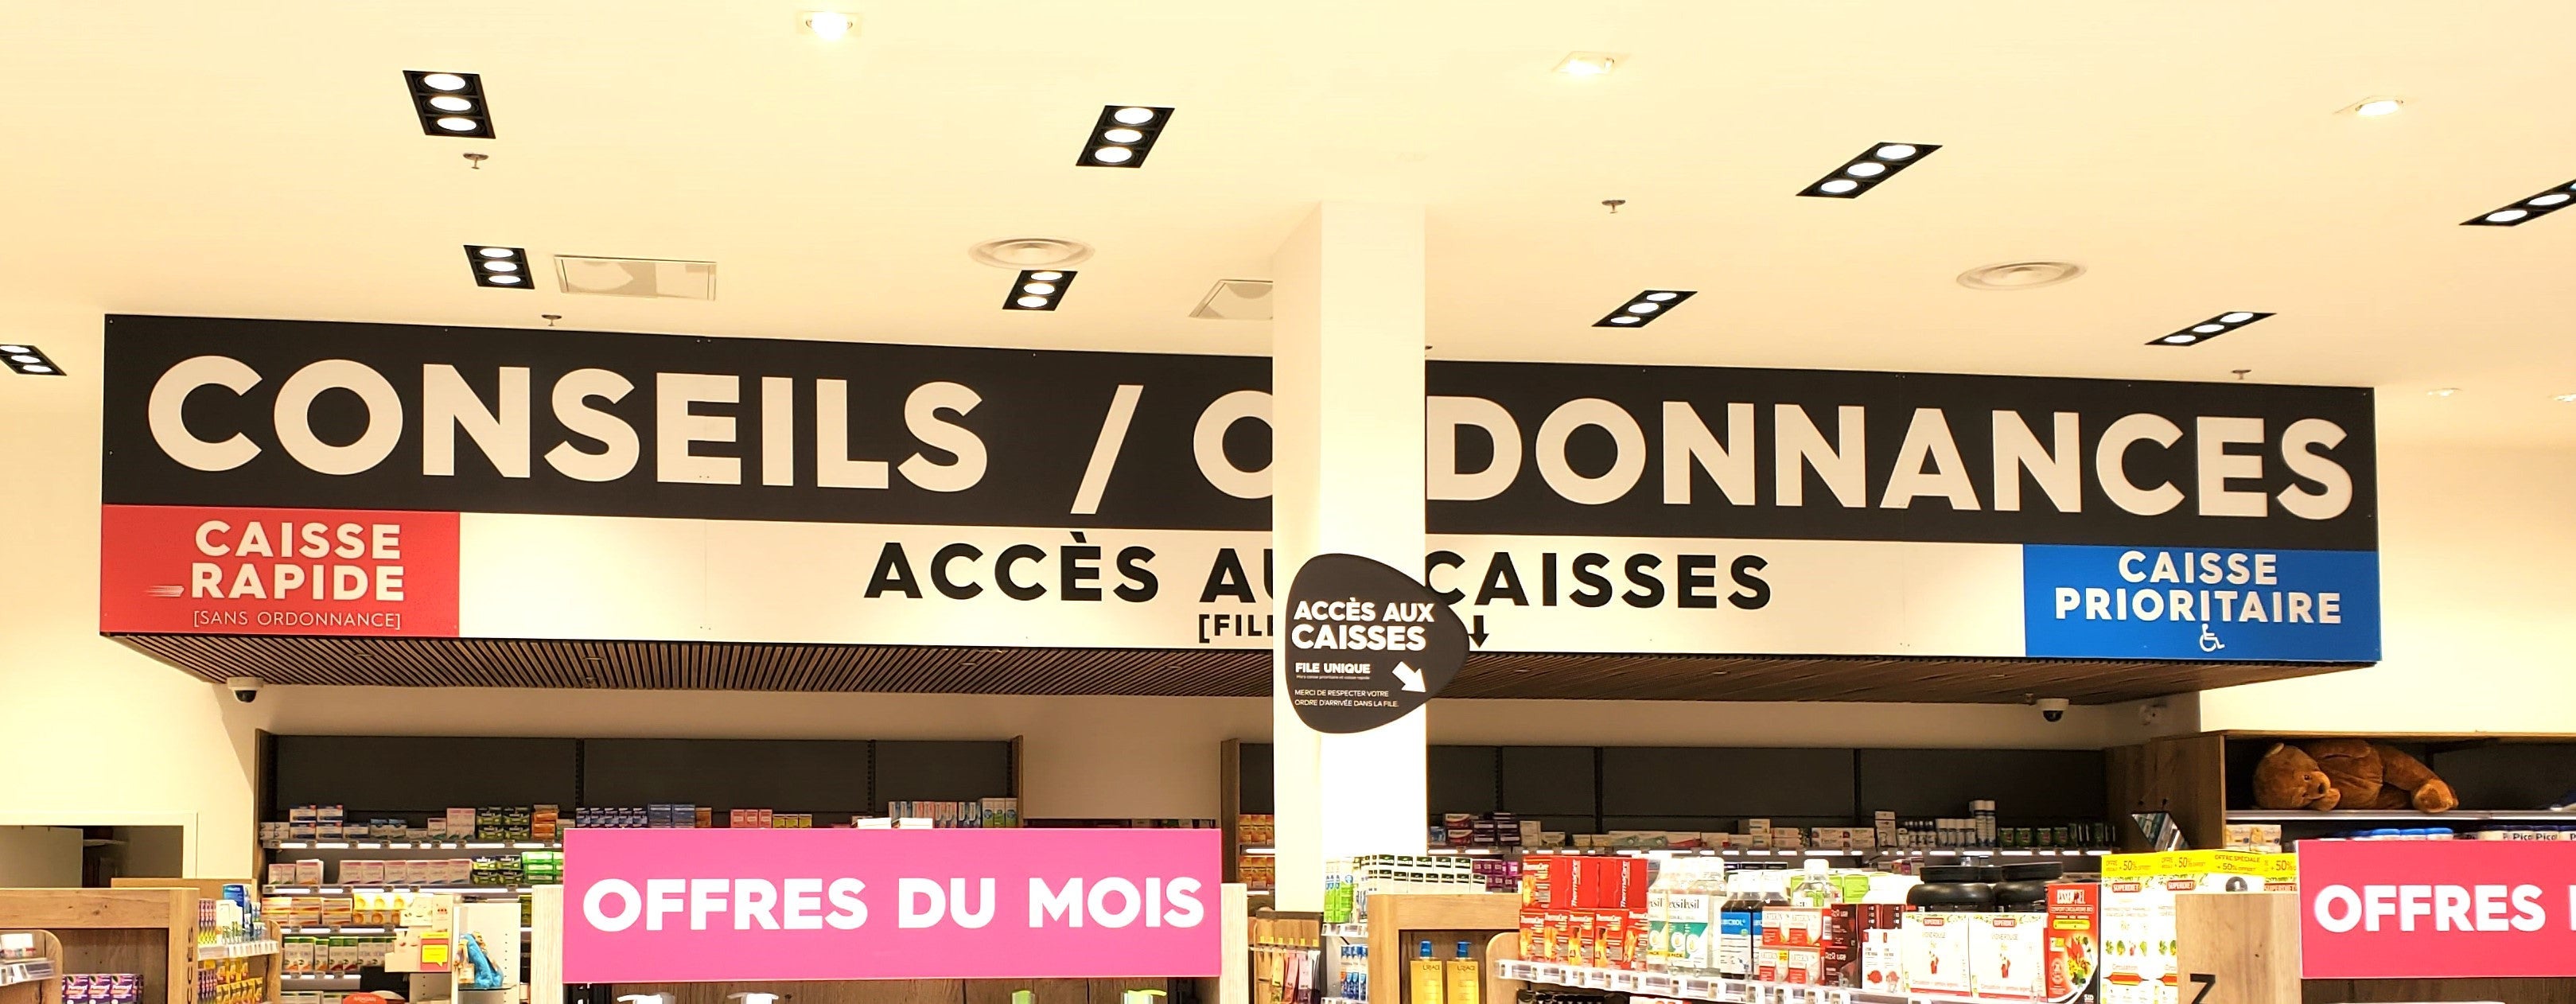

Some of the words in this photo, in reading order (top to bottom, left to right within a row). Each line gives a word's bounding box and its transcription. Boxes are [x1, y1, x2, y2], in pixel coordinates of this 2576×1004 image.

[148, 355, 988, 493] CONSEILS
[1193, 390, 2352, 520] ODONNANCES
[195, 520, 401, 559] CAISSE
[191, 563, 404, 602] RAPIDE
[864, 531, 1159, 602] ACCÈS
[1426, 551, 1772, 609] CAISSES
[2118, 550, 2278, 586] CAISSE
[1293, 597, 1376, 622] ACCÈS
[1382, 602, 1434, 623] AUX
[2055, 587, 2341, 625] PRIORITAIRE
[1291, 624, 1426, 652] CAISSES
[1295, 662, 1320, 673] FILE
[1324, 663, 1371, 674] UNIQUE
[582, 878, 868, 932] OFFRES
[898, 878, 995, 929] DU
[1029, 877, 1204, 929] MOIS
[2314, 884, 2546, 933] OFFRES
